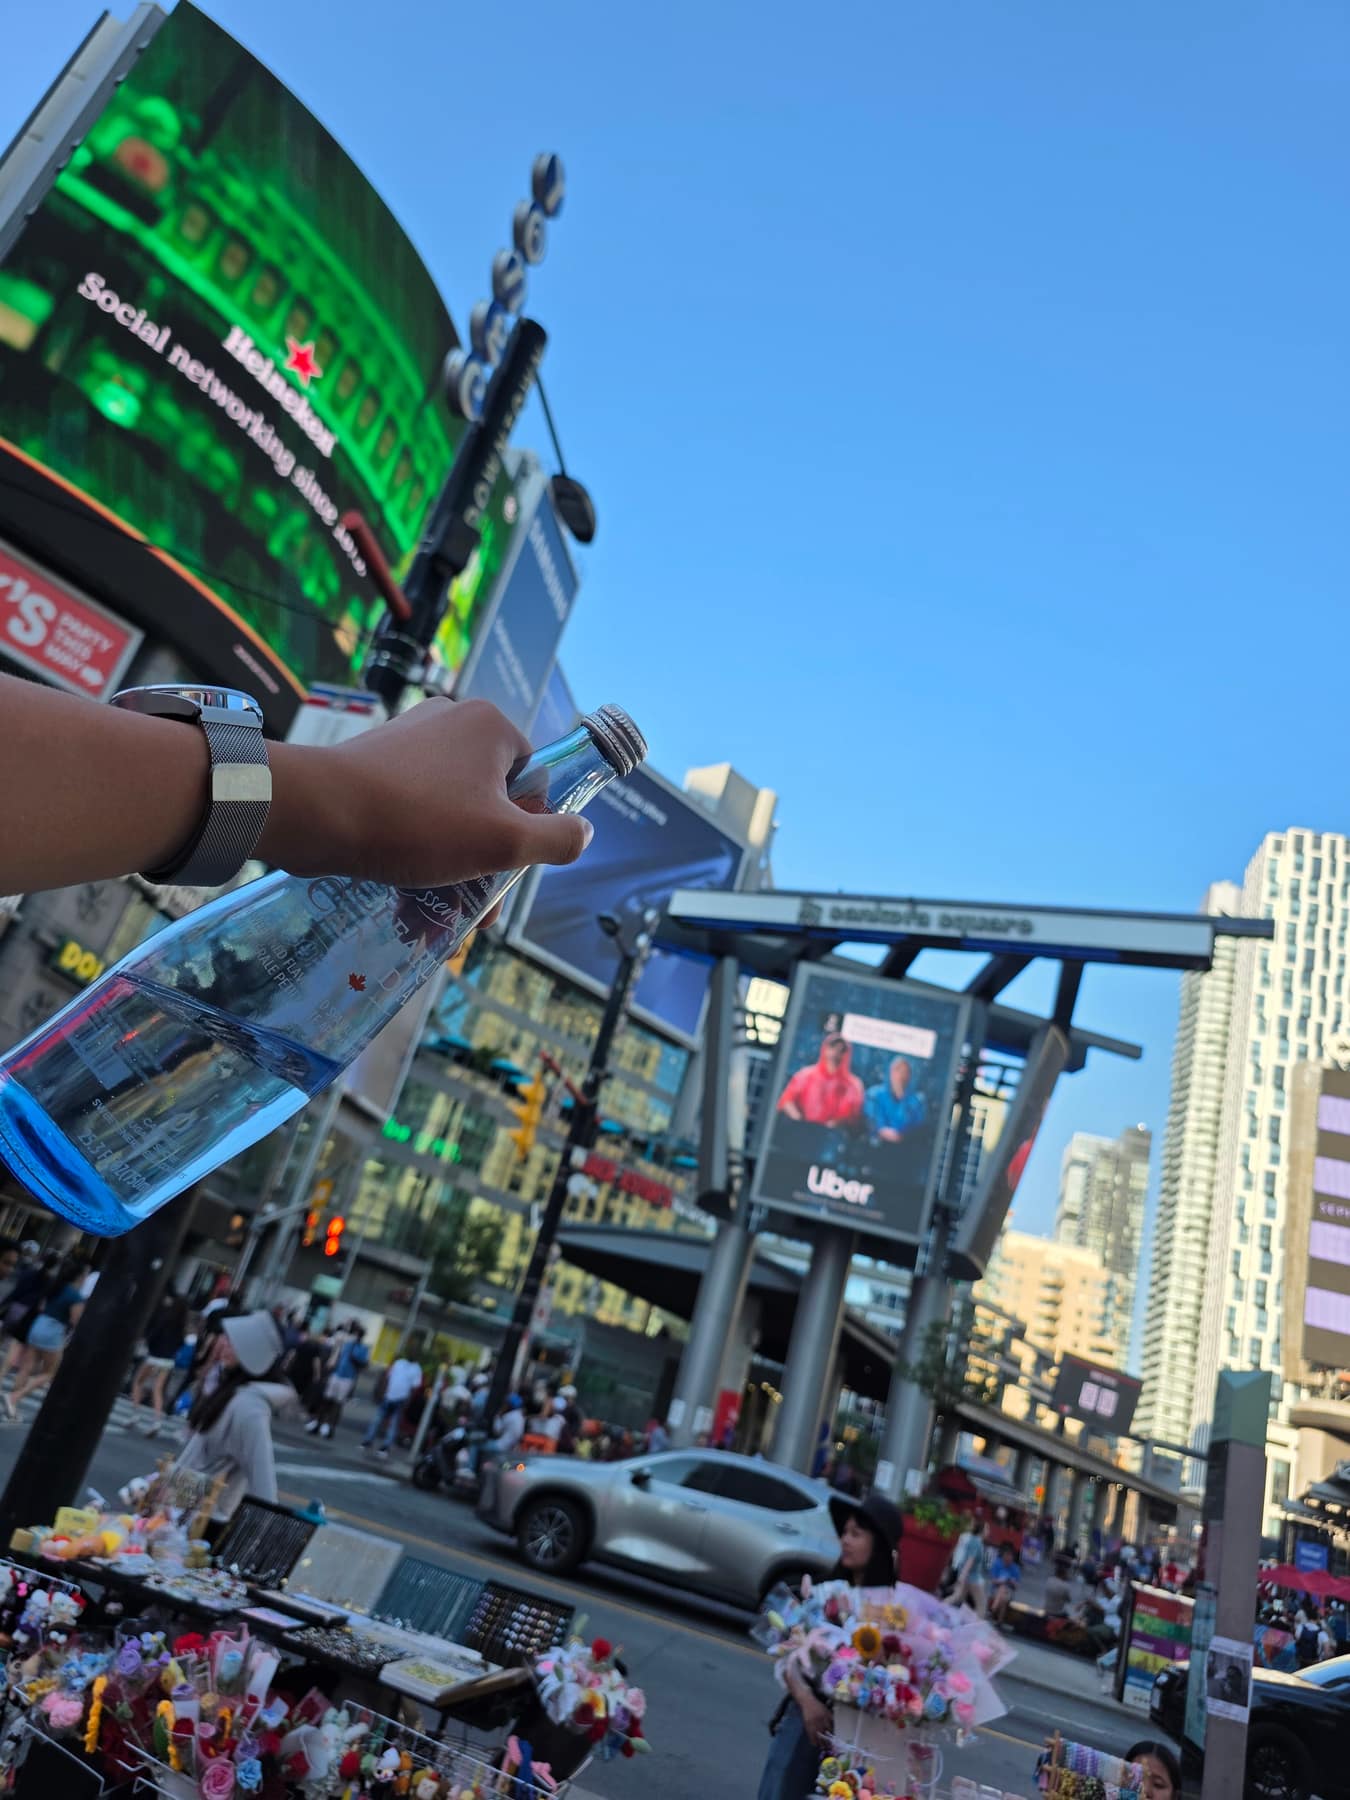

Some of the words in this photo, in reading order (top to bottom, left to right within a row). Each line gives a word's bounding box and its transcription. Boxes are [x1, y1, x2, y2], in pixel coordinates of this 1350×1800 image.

[77, 272, 172, 354] Social
[168, 344, 296, 477] networking
[292, 465, 338, 526] since
[222, 326, 338, 457] Heineken
[416, 886, 471, 931] ssence
[829, 901, 931, 930] sankofa
[938, 912, 1035, 937] square
[806, 1163, 874, 1206] Uber
